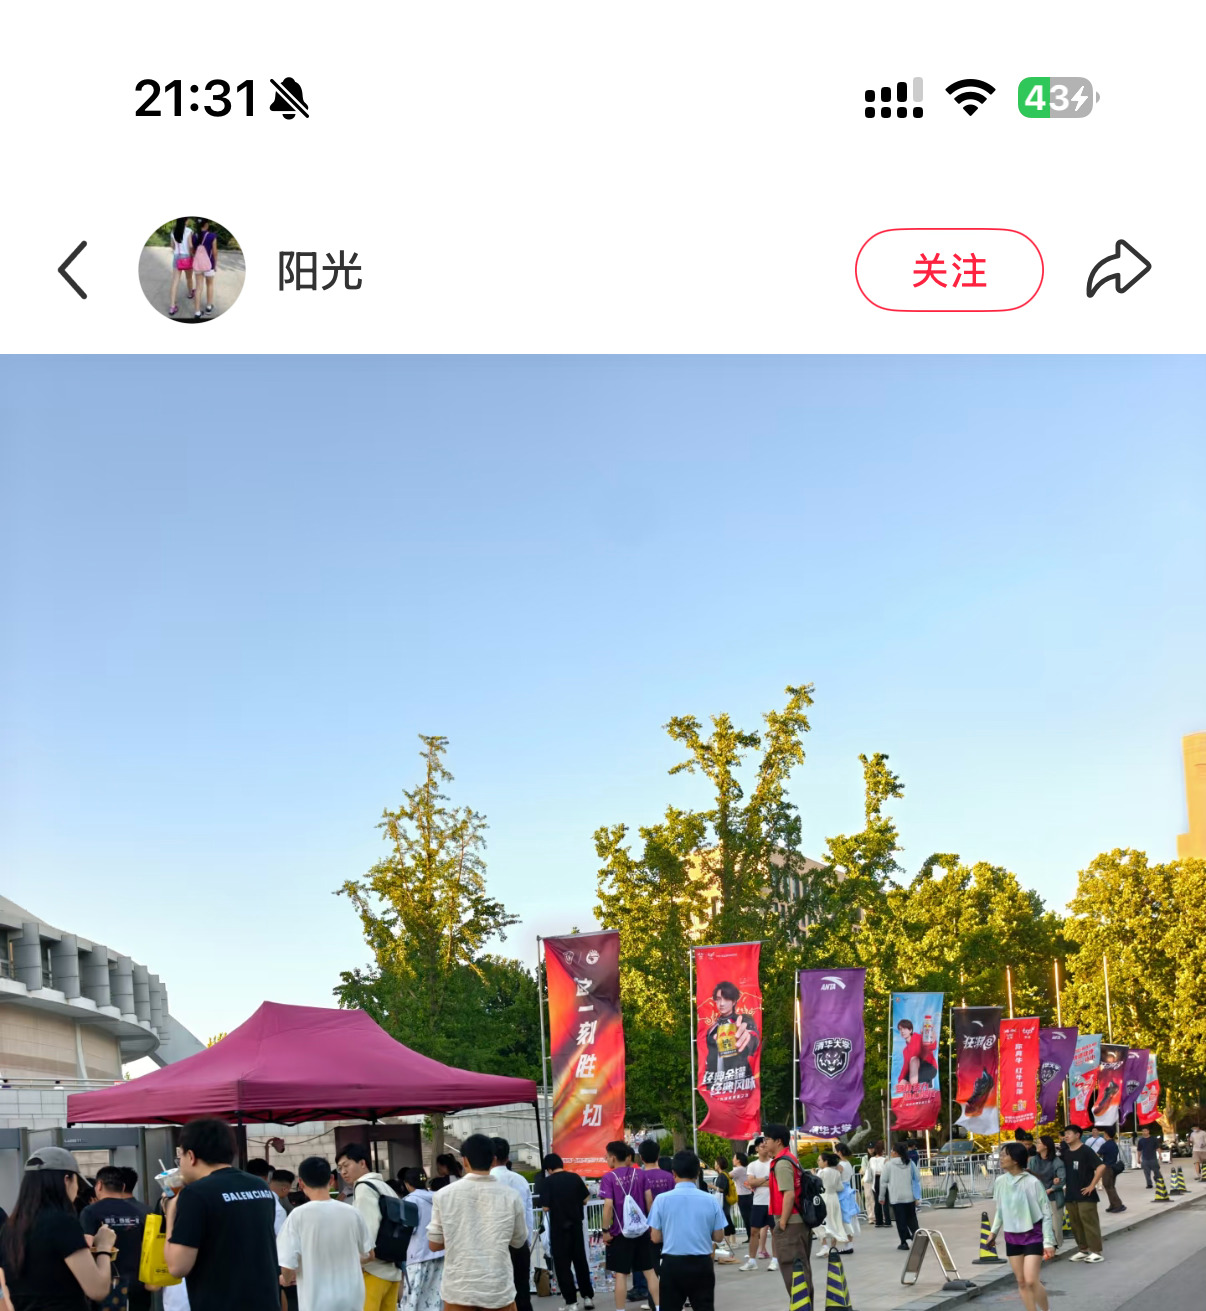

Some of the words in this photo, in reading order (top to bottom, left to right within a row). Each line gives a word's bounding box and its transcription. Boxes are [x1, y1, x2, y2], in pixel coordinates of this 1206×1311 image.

[815, 1039, 851, 1051] 清华大学
[574, 977, 602, 1127] 这一刻胜一切
[809, 1124, 852, 1135] 清华大学
